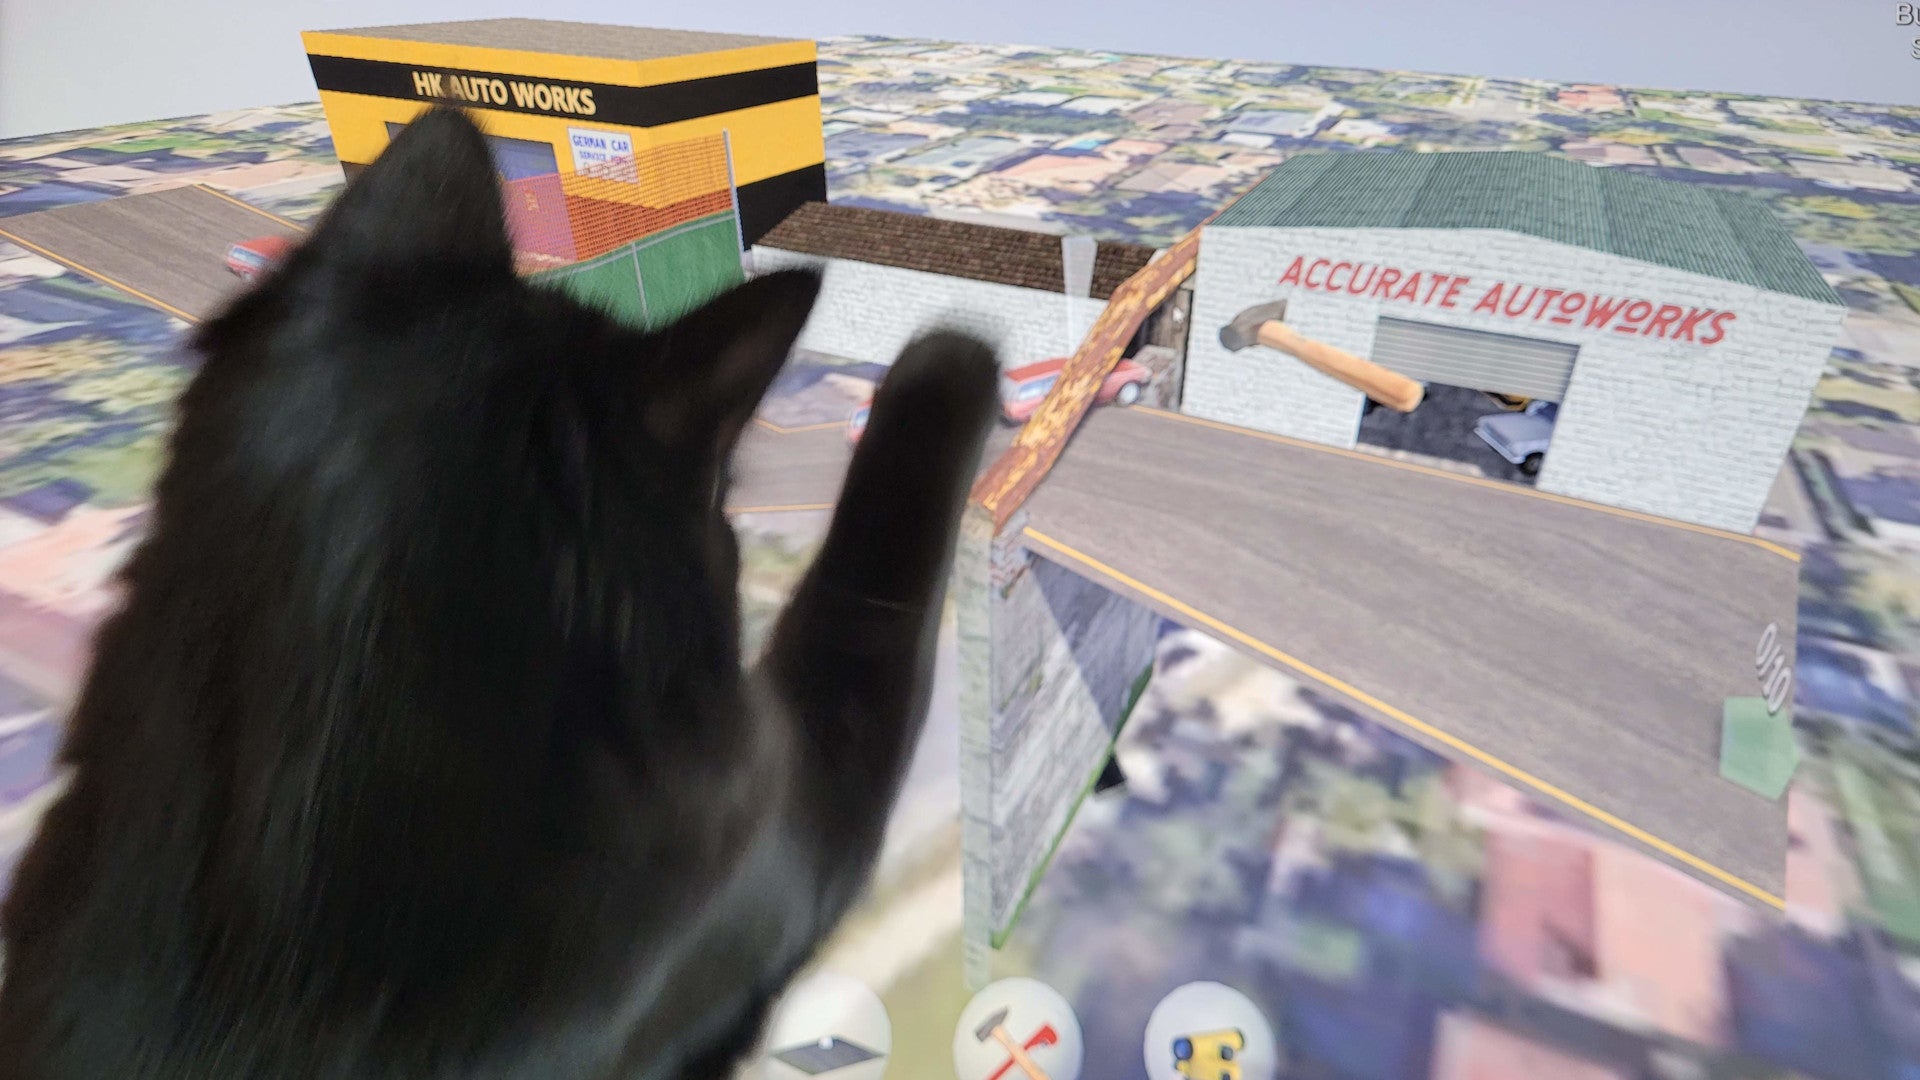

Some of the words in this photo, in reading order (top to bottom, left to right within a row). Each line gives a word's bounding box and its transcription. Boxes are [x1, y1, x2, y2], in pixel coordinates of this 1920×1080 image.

[412, 71, 443, 98] HK
[450, 75, 508, 105] AUTO
[509, 81, 597, 115] WORKS
[572, 135, 606, 149] GERMAN
[611, 139, 630, 153] CAR
[1278, 256, 1470, 308] ACCURATE
[1473, 282, 1737, 345] AUTOWORKS
[1756, 622, 1791, 716] 0/10
